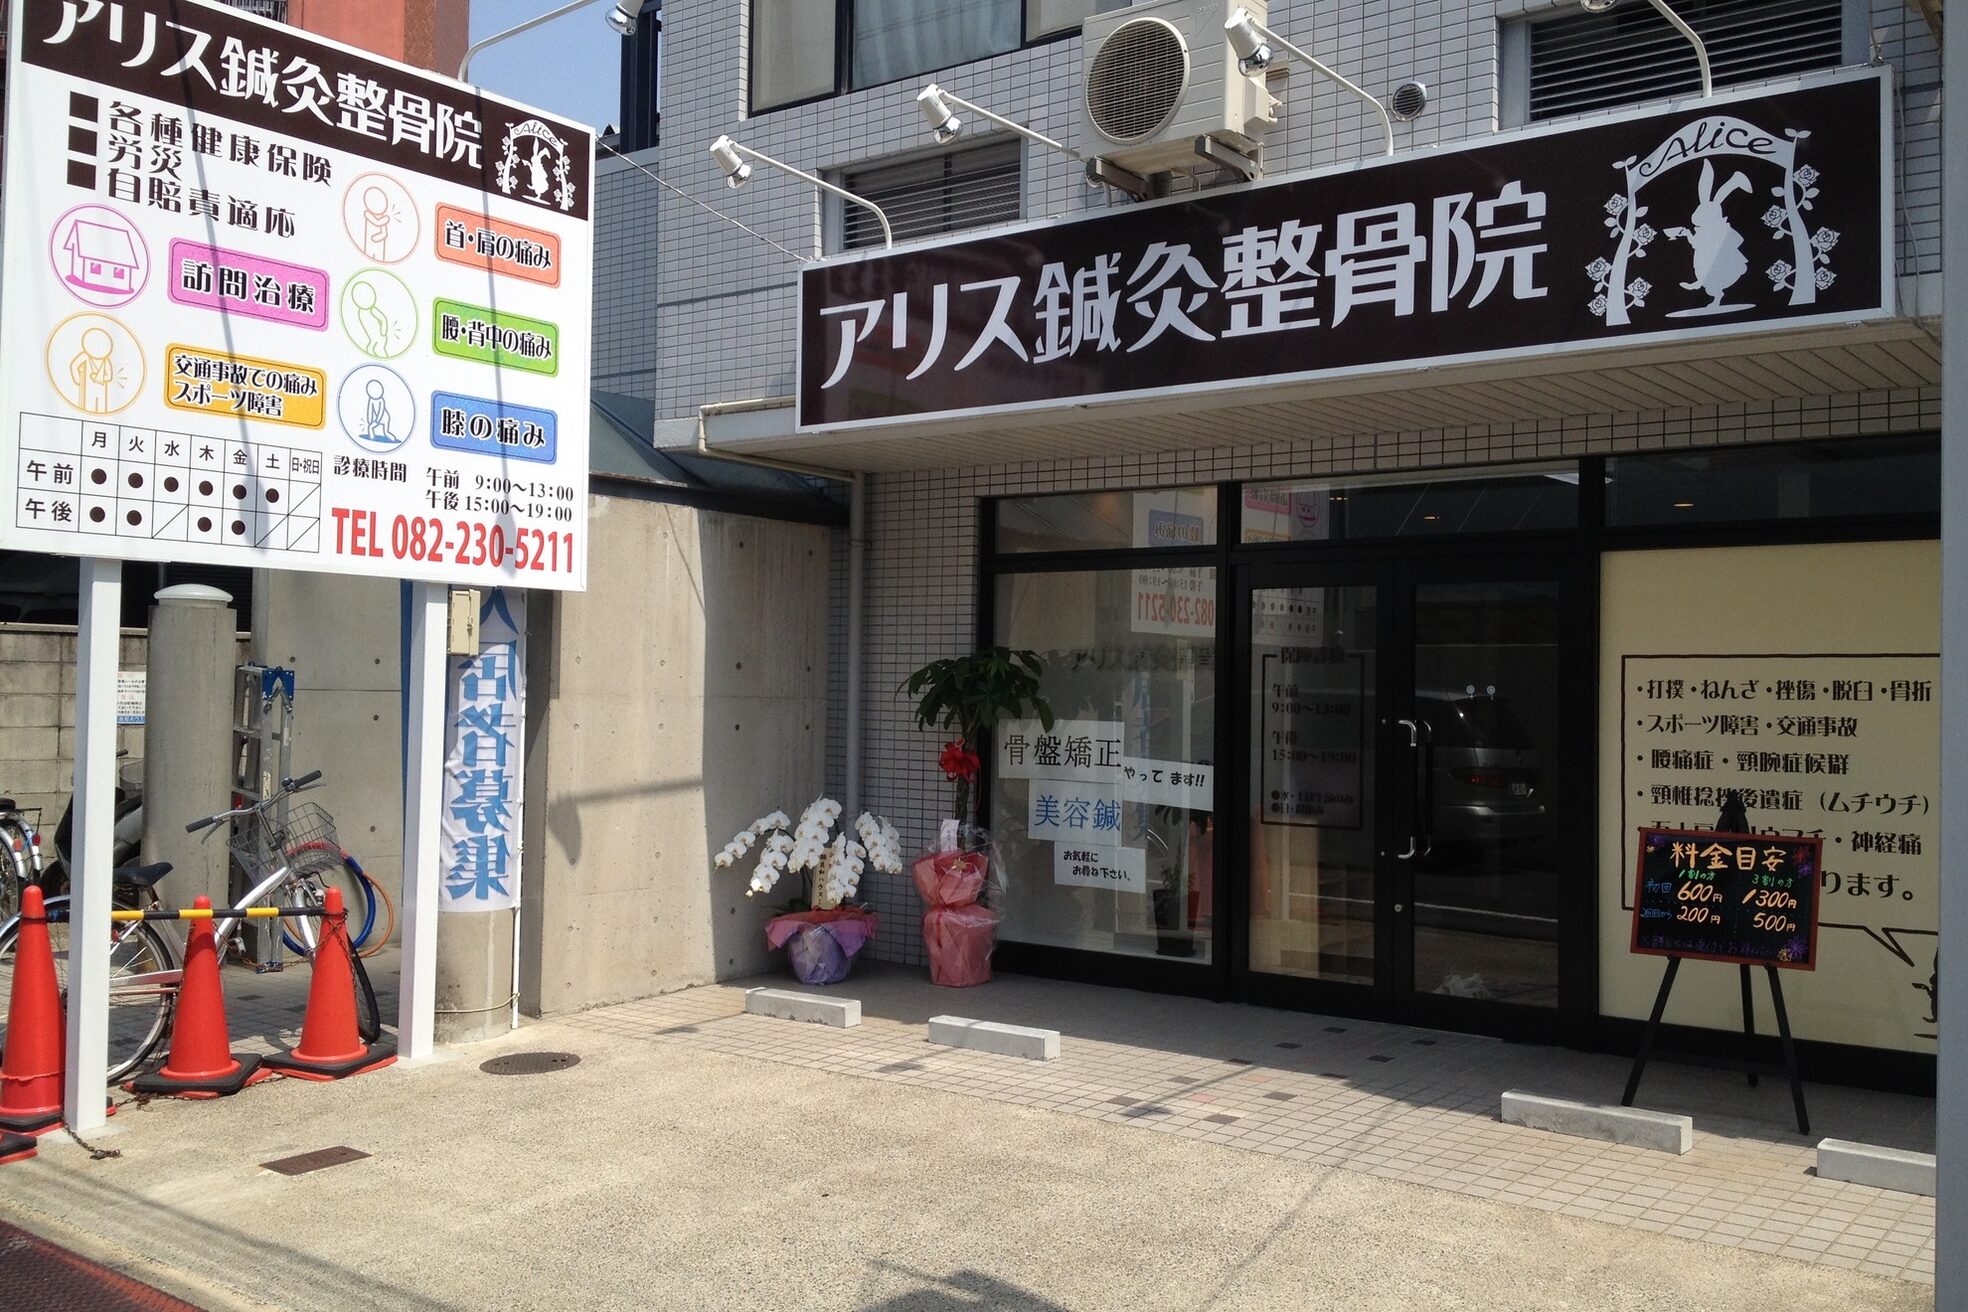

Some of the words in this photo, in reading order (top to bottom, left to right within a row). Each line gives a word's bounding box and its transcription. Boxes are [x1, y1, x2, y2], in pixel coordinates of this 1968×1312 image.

[42, 0, 483, 169] アリス鍼灸整骨院
[109, 101, 331, 187] 各種健康保険
[514, 122, 559, 150] Alice
[1639, 120, 1779, 178] Alice
[108, 134, 183, 181] 労災
[107, 168, 295, 238] 自賠責適応
[445, 221, 551, 269] 首・肩の痛み
[183, 260, 315, 313] 訪問治療
[820, 180, 1549, 390] アリス鍼灸整骨院
[442, 314, 551, 359] 腰・背中の痛み
[174, 355, 318, 396] 交通事故での痛み
[174, 381, 282, 416] スポーツ障害
[442, 409, 545, 447] 膝の痛み
[91, 432, 107, 448] 月
[129, 436, 144, 452] 火
[164, 441, 180, 457] 水
[199, 445, 214, 461] 木
[233, 450, 248, 465] 金
[265, 454, 280, 469] 土
[26, 460, 73, 485] 午前
[334, 455, 407, 483] 診療時間
[425, 467, 460, 489] 午前
[25, 498, 73, 522] 午後
[425, 490, 459, 511] 午後
[332, 507, 384, 558] TEL
[391, 514, 573, 573] 082-230-5211
[1004, 733, 1121, 768] 骨盤矯正
[1035, 794, 1121, 832] 美容鍼
[1063, 850, 1099, 863] お気軽に
[1670, 841, 1786, 872] 料金目安
[1677, 880, 1723, 902] 600円
[1676, 905, 1720, 925] 200円
[1753, 912, 1796, 933] 500円
